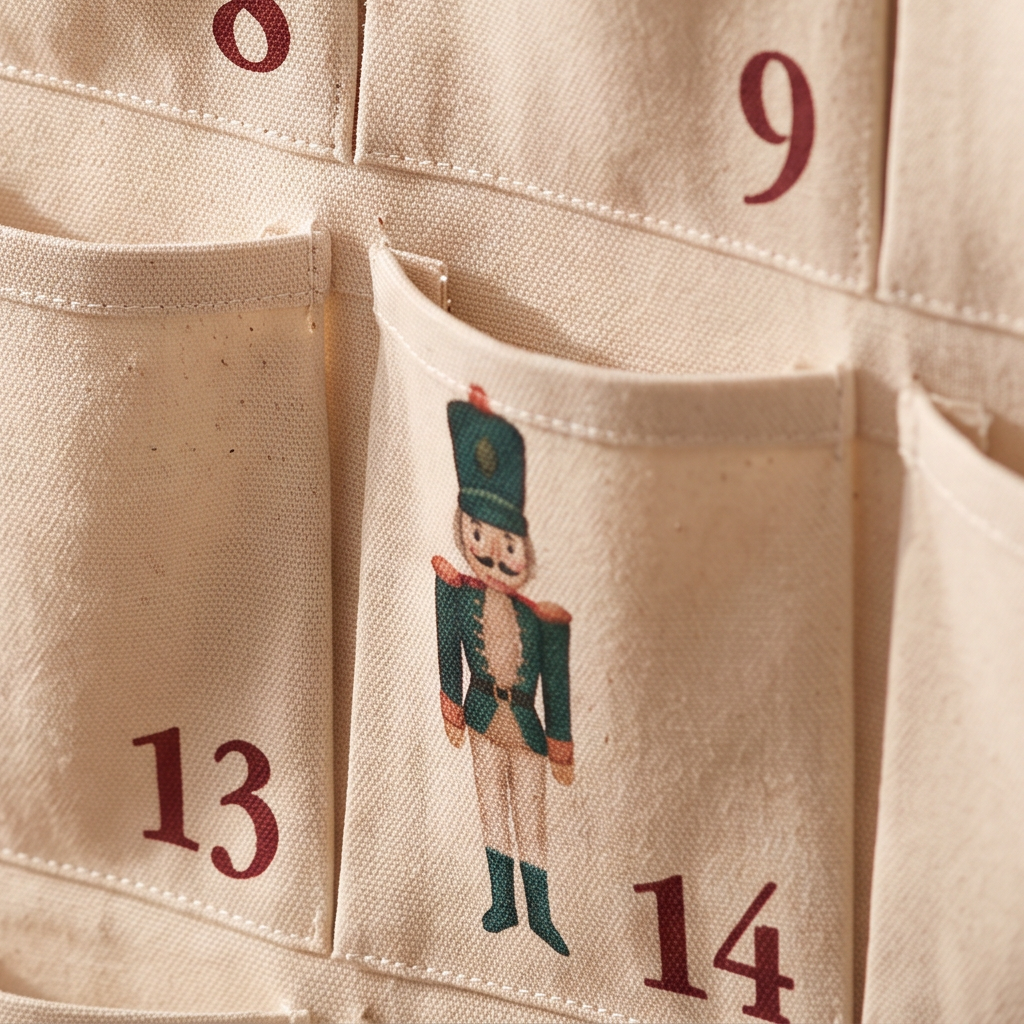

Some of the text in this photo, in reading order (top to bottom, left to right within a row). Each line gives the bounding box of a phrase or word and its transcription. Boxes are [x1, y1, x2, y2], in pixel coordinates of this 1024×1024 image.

[738, 51, 816, 205] 9
[131, 726, 280, 880] 13
[632, 874, 795, 1024] 14
